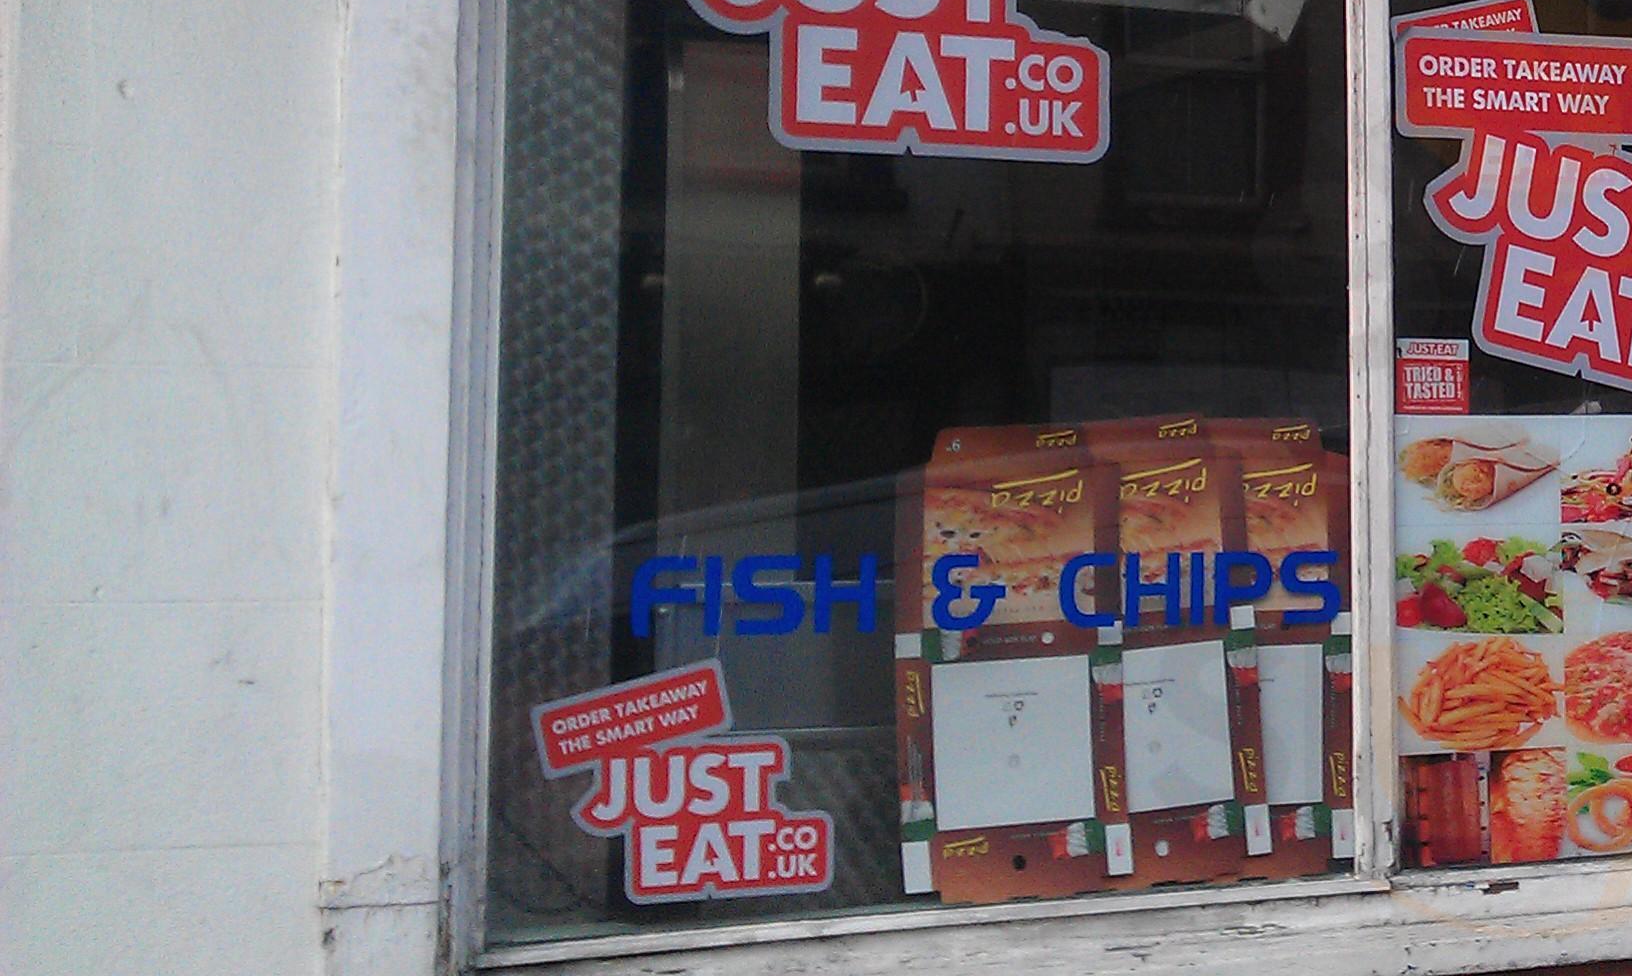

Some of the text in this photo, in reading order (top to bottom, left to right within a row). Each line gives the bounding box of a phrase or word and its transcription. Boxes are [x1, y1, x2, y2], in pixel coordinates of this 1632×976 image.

[796, 25, 1083, 132] EAT .CO
[1419, 55, 1627, 85] ORDER TAKEAWAY
[1004, 100, 1083, 138] .UK
[1423, 87, 1610, 116] THE SMART WAY
[1404, 366, 1442, 382] TRIED
[1444, 368, 1455, 382] &
[1405, 383, 1456, 399] TASTED
[991, 479, 1084, 514] pizza
[630, 550, 1342, 638] FISH & CHIPS
[552, 679, 709, 736] ORDER TAKEAWAY
[558, 705, 701, 755] THE SMART WAY
[592, 752, 776, 822] JUST
[640, 820, 818, 889] EAT .CO
[768, 853, 818, 879] .UK
